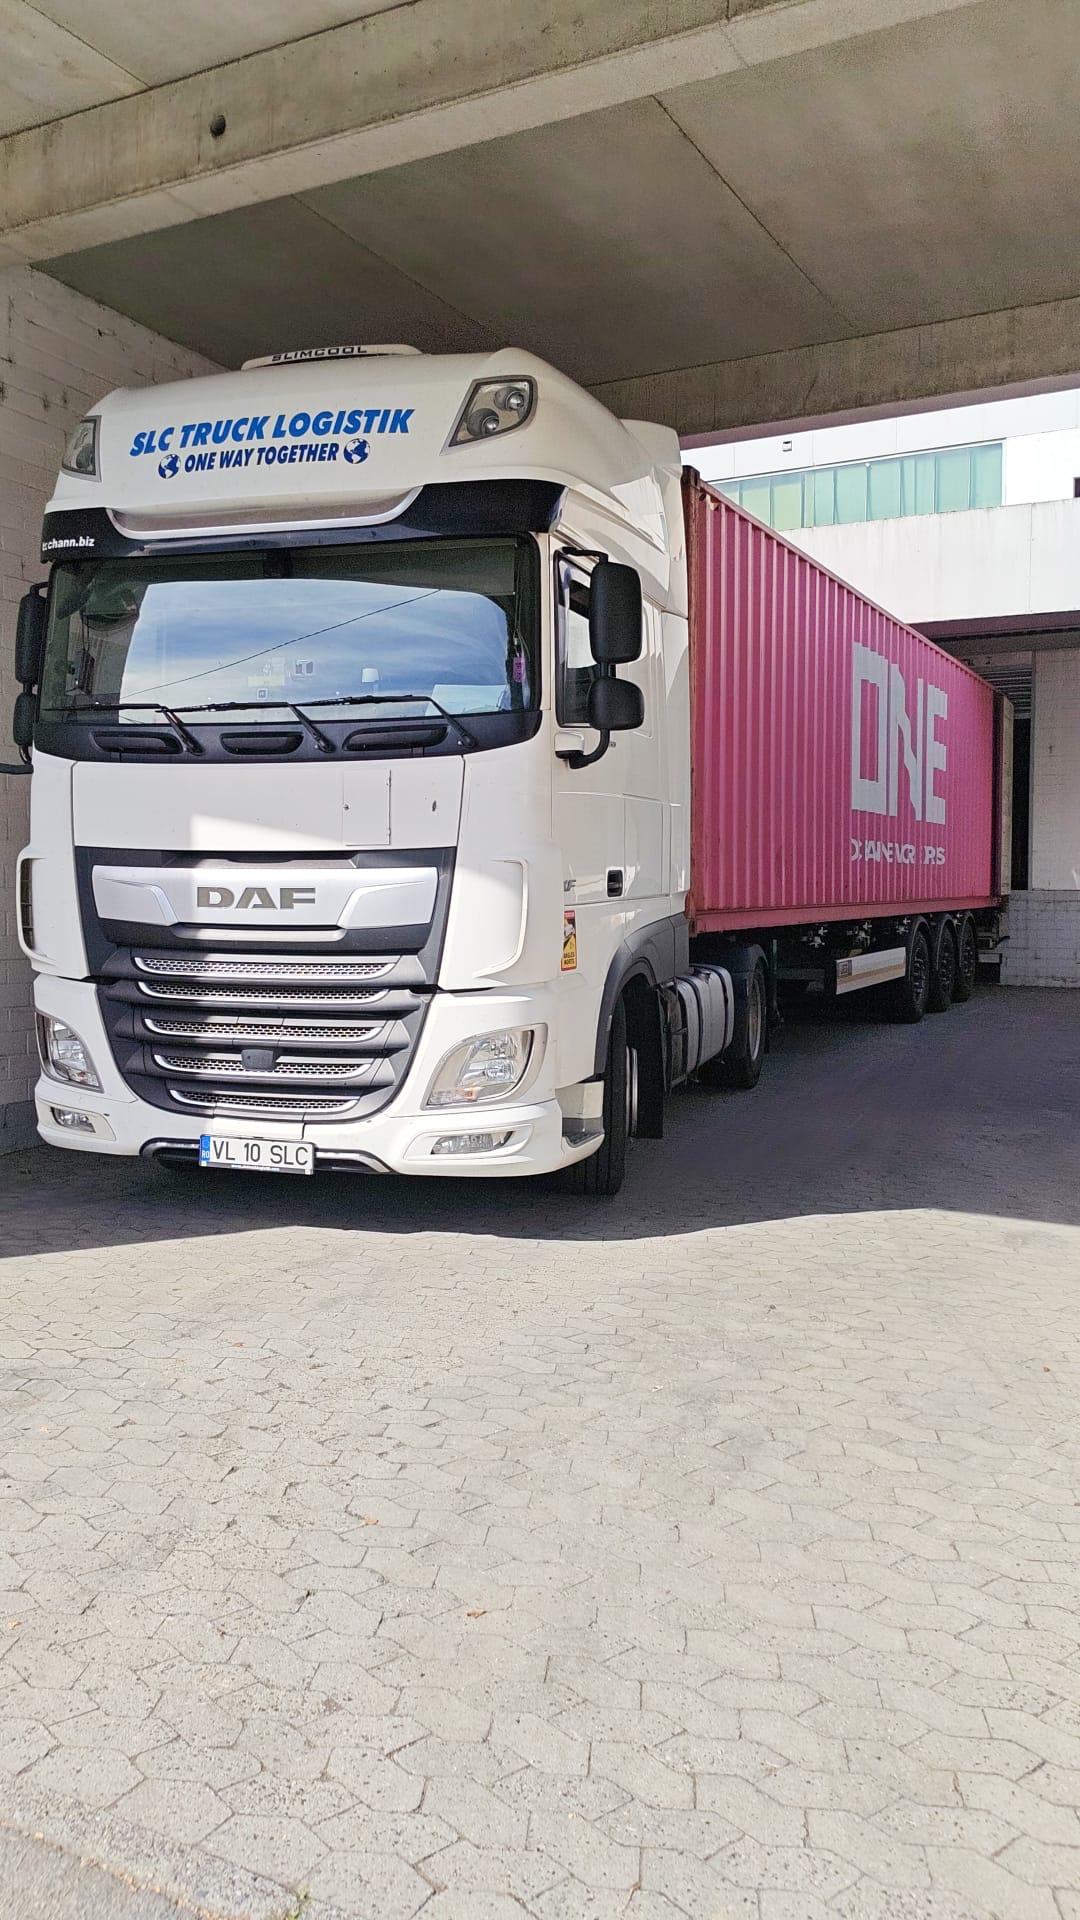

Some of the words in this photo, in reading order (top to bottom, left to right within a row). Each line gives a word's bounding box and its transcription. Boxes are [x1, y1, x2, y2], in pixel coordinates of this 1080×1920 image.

[272, 346, 367, 362] SLIMCOOL
[130, 427, 174, 457] SLC
[180, 416, 270, 448] TRUCK
[272, 408, 415, 438] LOGISTIK
[184, 452, 217, 473] ONE
[219, 448, 254, 469] WAY
[256, 442, 339, 466] TOGETHER
[852, 641, 948, 826] ONE
[197, 886, 316, 910] DAF
[213, 1140, 235, 1161] VL
[244, 1142, 260, 1162] 10
[270, 1145, 308, 1166] SLC
